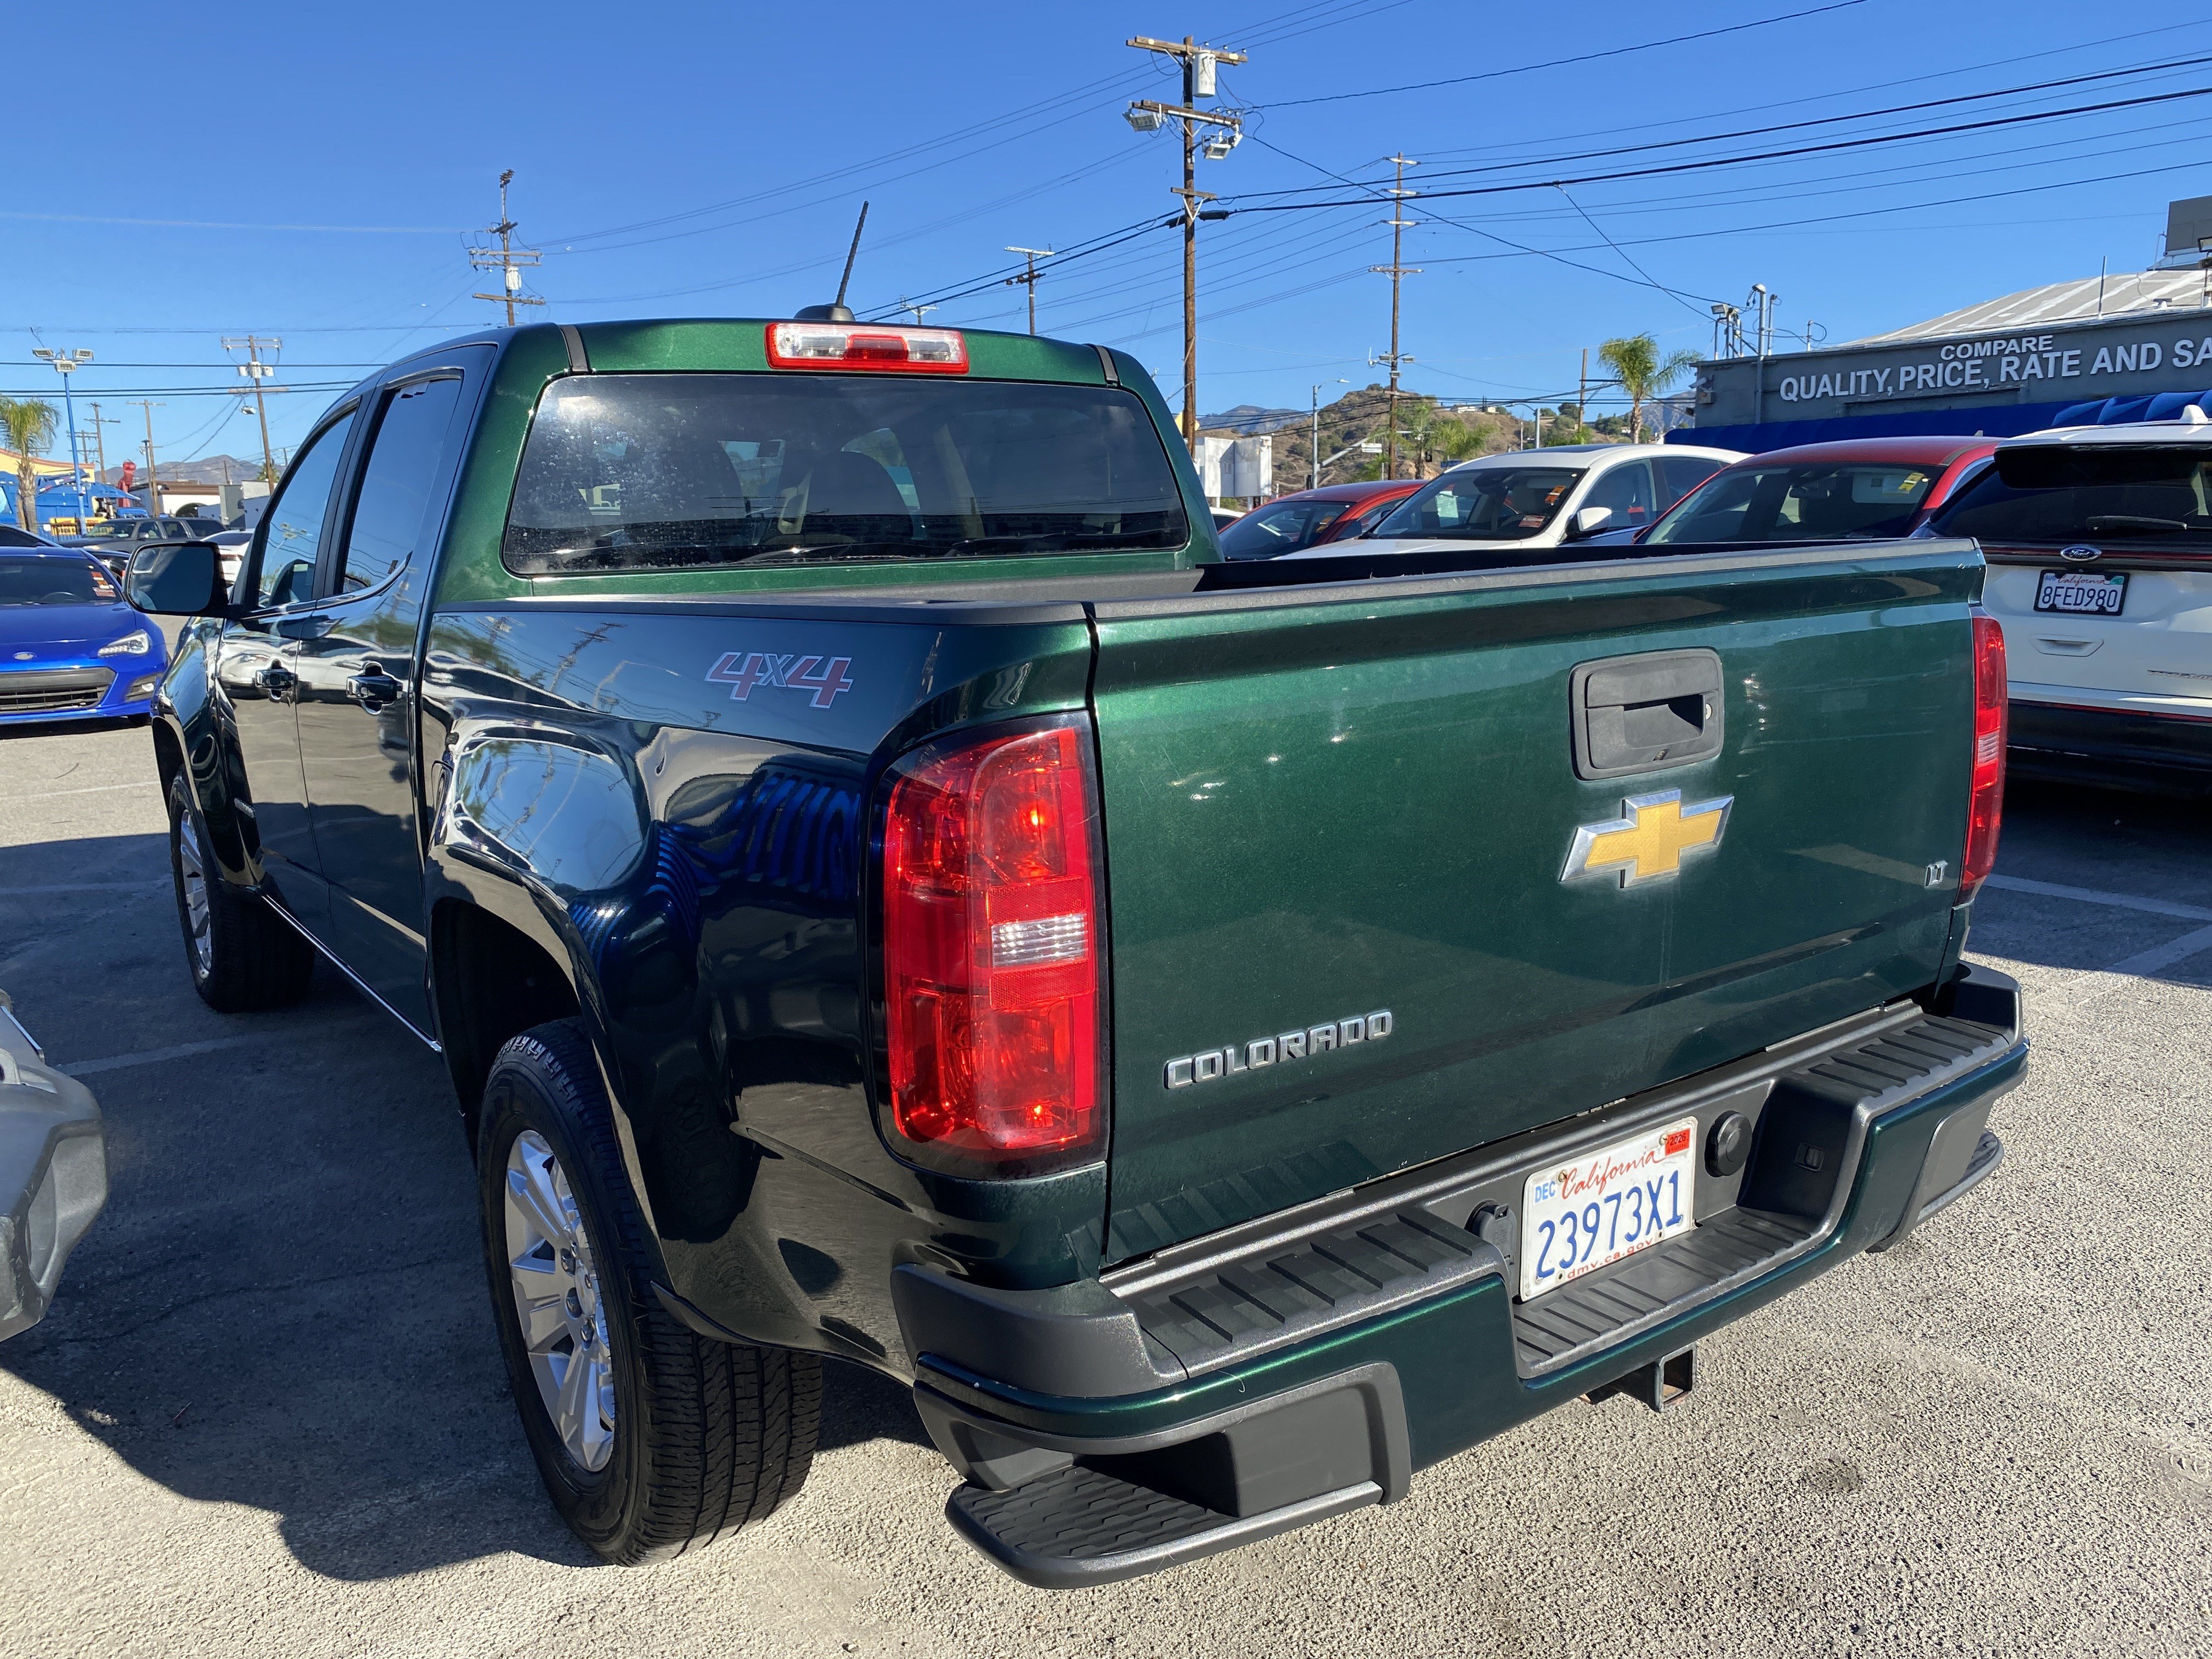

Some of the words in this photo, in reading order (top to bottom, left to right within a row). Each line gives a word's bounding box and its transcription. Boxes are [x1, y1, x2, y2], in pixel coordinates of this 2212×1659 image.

[1779, 368, 1893, 402] QUALITY,
[1899, 358, 1990, 390] PRICE,
[2000, 349, 2081, 382] RATE
[2090, 342, 2163, 375] AND
[1940, 335, 2053, 361] COMPARE
[2042, 586, 2118, 608] 8FED980
[2058, 574, 2110, 586] California
[1163, 1010, 1393, 1090] COLORADO
[1535, 1181, 1556, 1203] DEC
[1561, 1146, 1666, 1200] California
[1536, 1169, 1684, 1280] 23973X1
[1567, 1238, 1654, 1280] dmv.ca.gov
